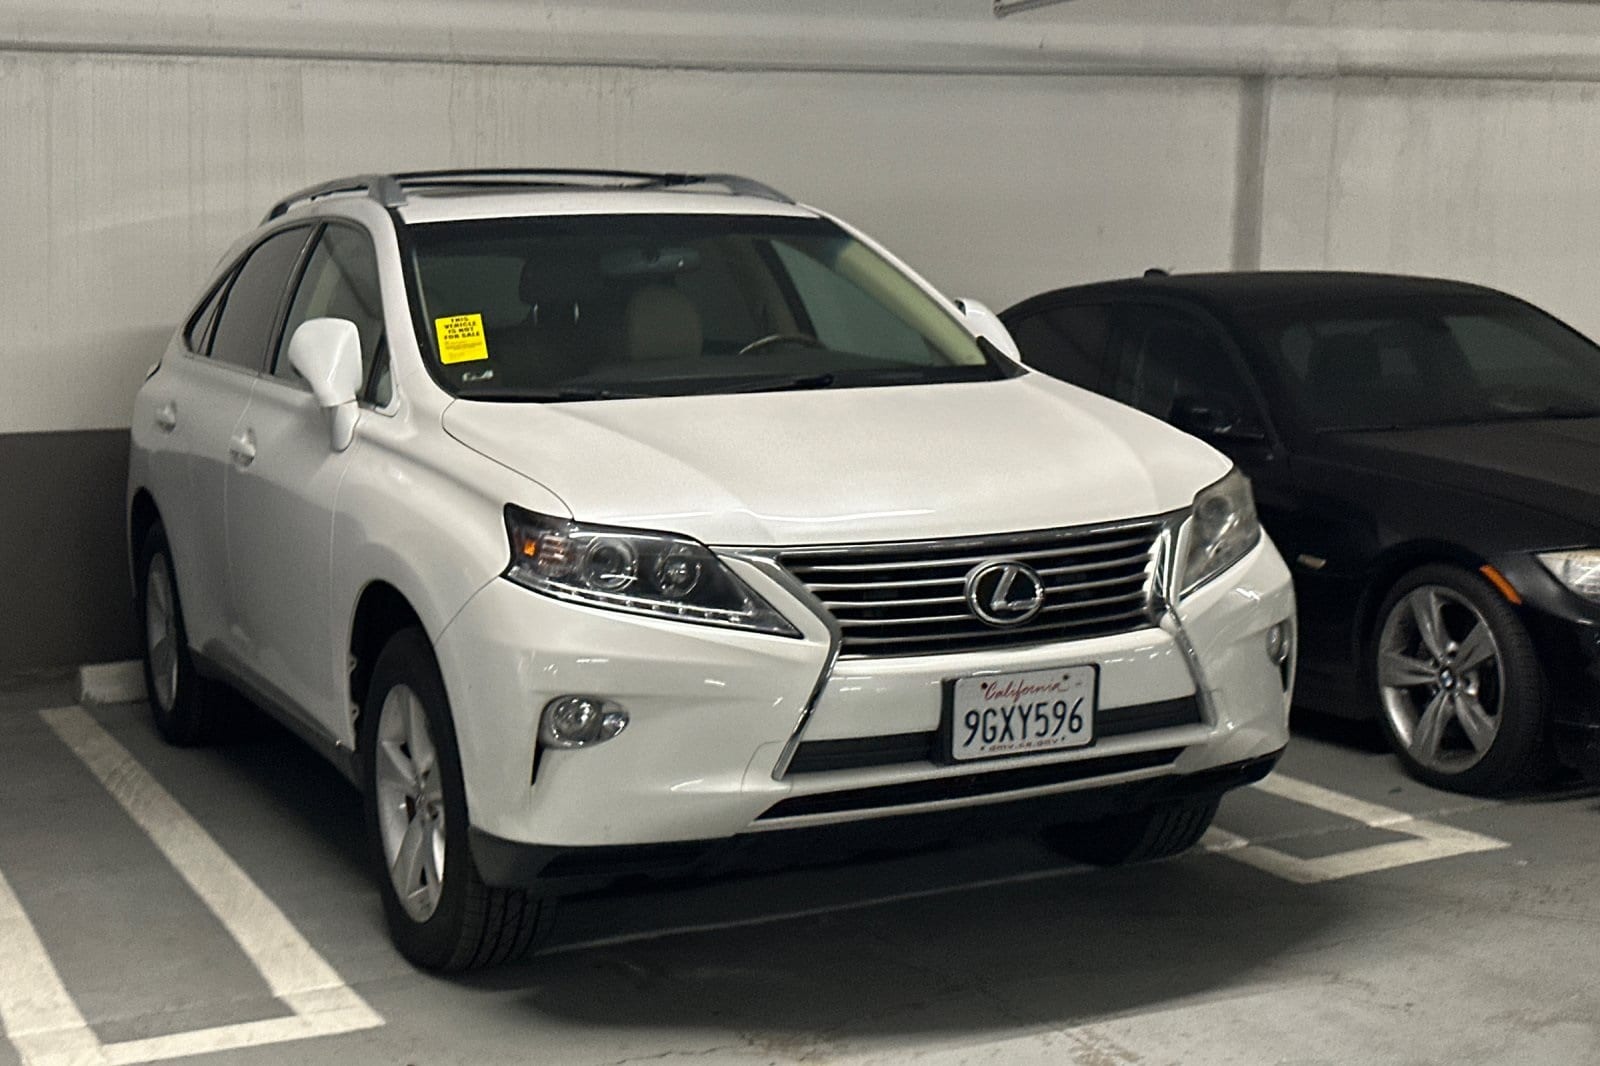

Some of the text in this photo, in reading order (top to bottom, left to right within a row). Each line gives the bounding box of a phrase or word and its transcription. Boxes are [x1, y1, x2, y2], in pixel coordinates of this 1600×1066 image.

[444, 321, 476, 329] VEHICLE
[984, 680, 1065, 702] California
[962, 697, 1084, 747] 9GXY596
